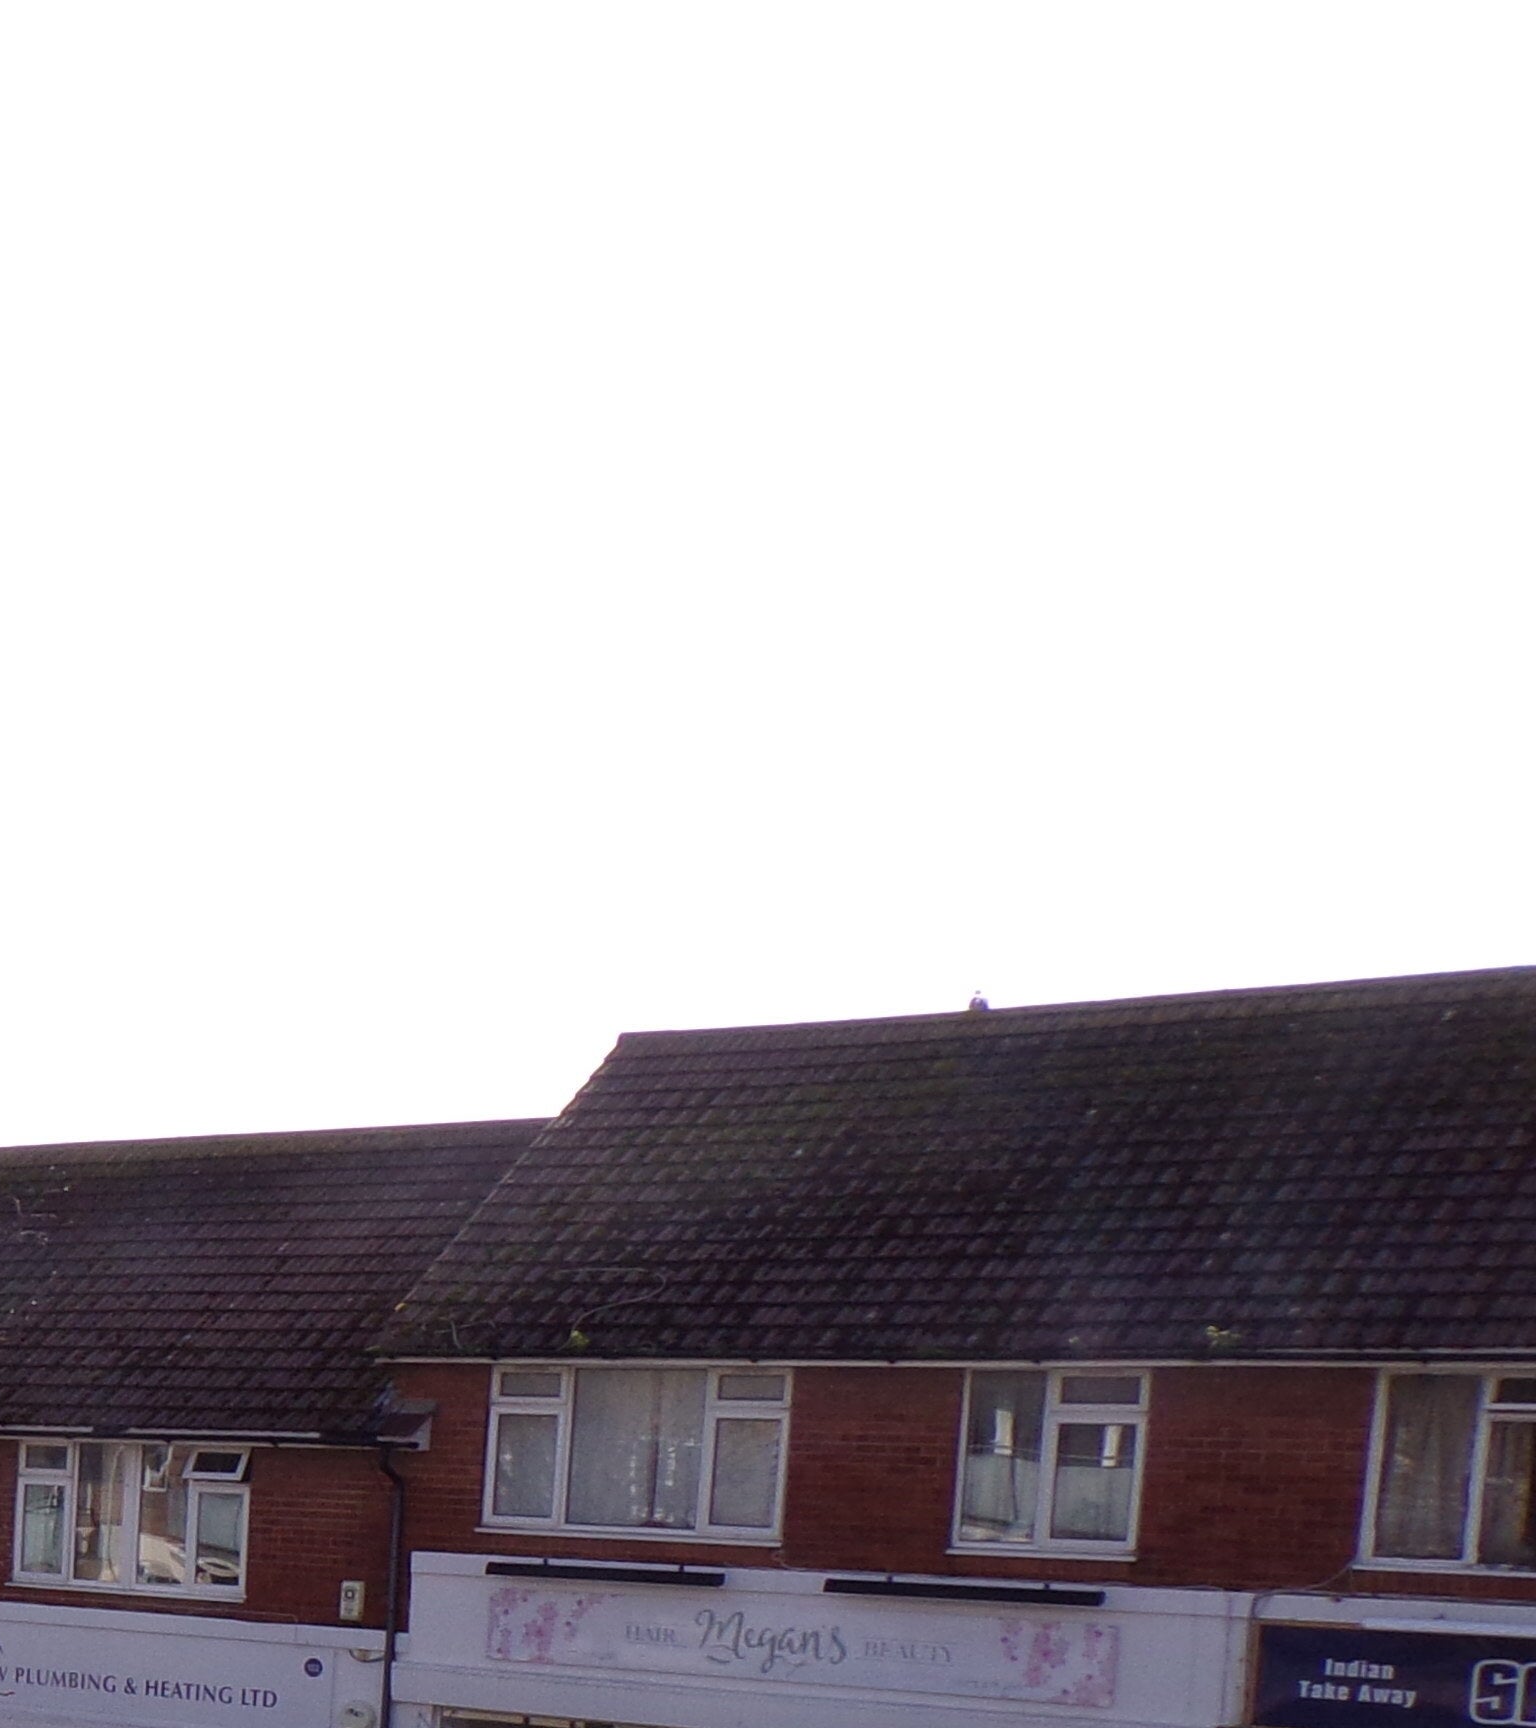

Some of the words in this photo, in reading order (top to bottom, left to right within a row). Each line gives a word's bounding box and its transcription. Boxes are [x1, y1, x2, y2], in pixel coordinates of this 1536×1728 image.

[625, 1624, 676, 1643] HAIR
[695, 1609, 847, 1673] Megan's
[1324, 1658, 1395, 1680] Indian
[15, 1668, 118, 1694] PLUMBING
[123, 1678, 138, 1696] &
[144, 1679, 234, 1705] HEATING
[241, 1688, 279, 1709] LTD
[1298, 1680, 1350, 1701] Take
[1357, 1684, 1417, 1708] Away
